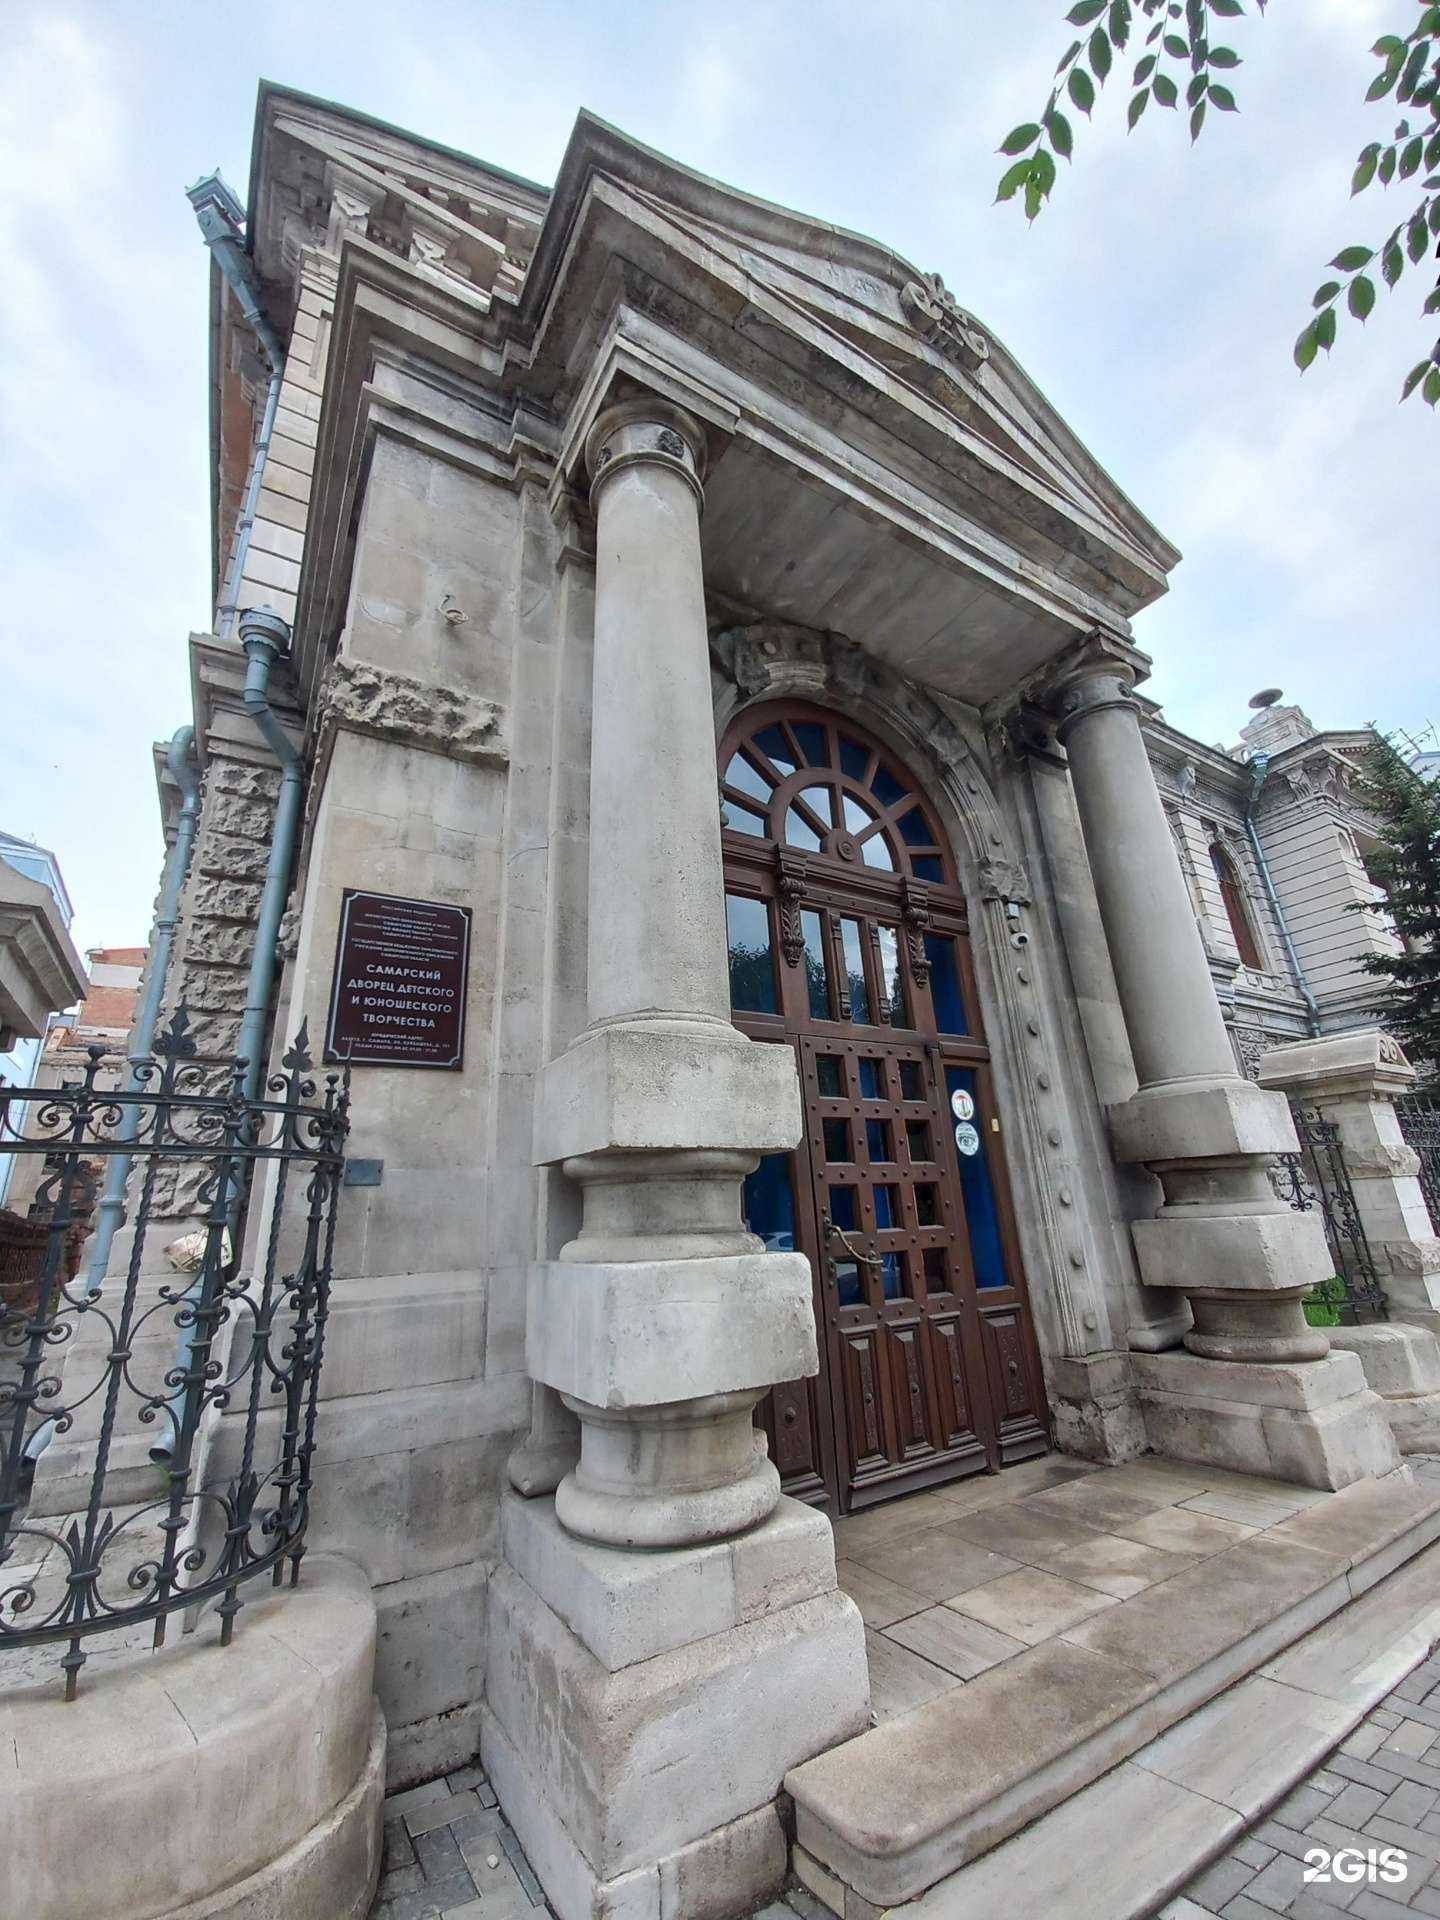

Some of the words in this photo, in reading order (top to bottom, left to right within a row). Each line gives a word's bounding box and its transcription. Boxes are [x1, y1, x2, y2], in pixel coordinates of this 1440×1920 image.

[366, 964, 441, 980] САМАРСКИЙ
[347, 979, 395, 992] ДВОРЕЦ
[397, 984, 455, 998] ДЕТСКОГО
[351, 996, 360, 1005] И
[364, 997, 452, 1013] ЮНОШЕСКОГО
[363, 1013, 436, 1028] ТВОРЧЕСТВА
